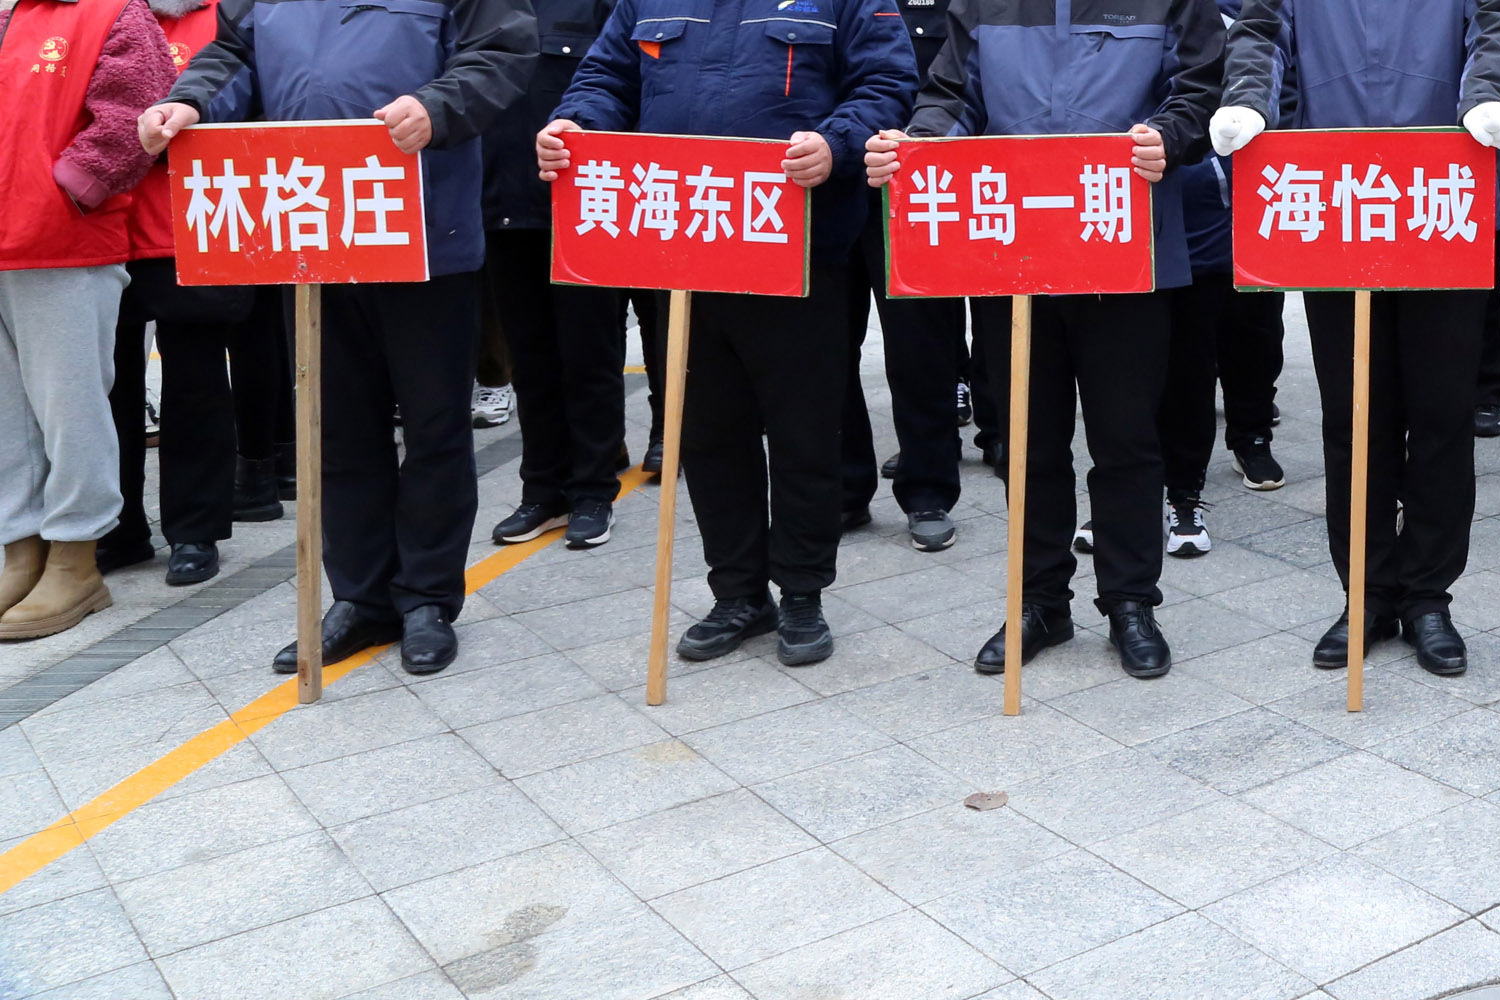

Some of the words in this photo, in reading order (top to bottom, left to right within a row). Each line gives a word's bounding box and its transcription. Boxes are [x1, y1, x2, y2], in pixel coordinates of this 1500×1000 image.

[184, 155, 410, 253] 林格庄
[575, 159, 790, 244] 黄海东区
[908, 164, 1133, 246] 半岛一期
[1257, 162, 1478, 243] 海怡城
